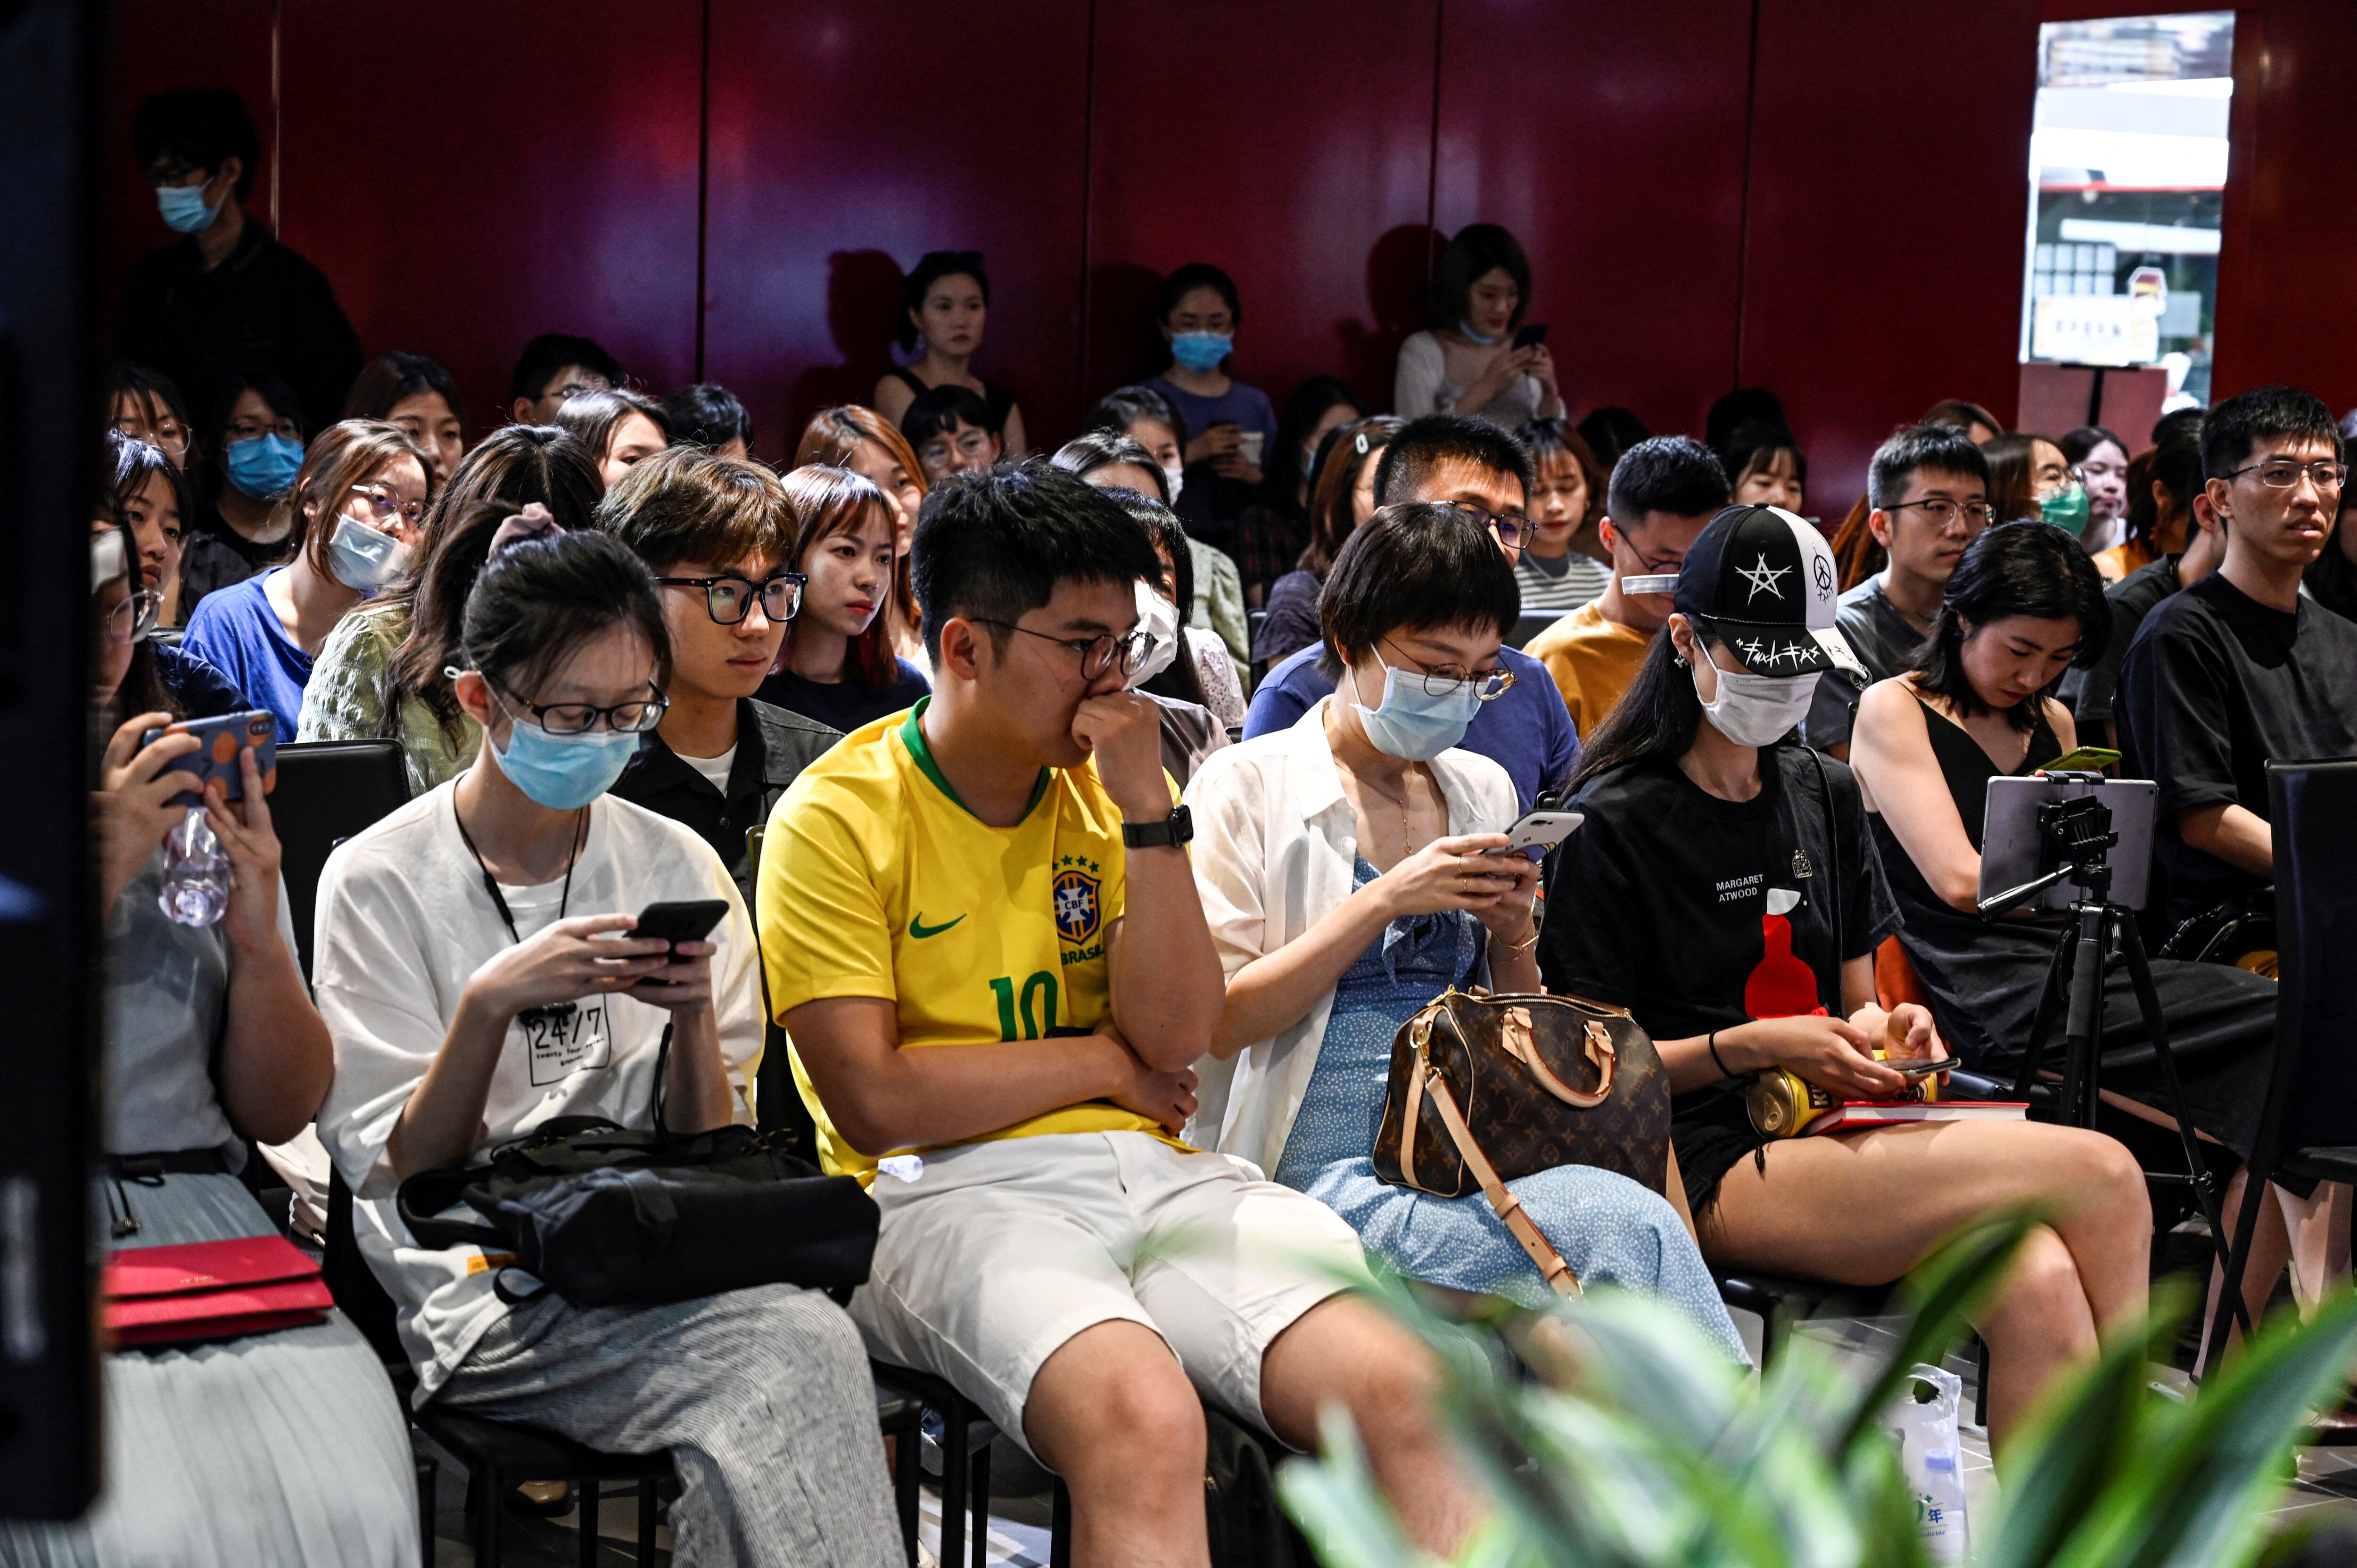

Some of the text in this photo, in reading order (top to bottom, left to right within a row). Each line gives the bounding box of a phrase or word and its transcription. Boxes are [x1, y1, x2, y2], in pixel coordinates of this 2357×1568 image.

[1716, 873, 1763, 891] MARGARET
[1064, 899, 1084, 910] CBF
[1719, 887, 1757, 903] ATWOOD
[1061, 944, 1104, 965] BRASIL
[989, 971, 1058, 1043] 10
[534, 1007, 601, 1049] 24/7
